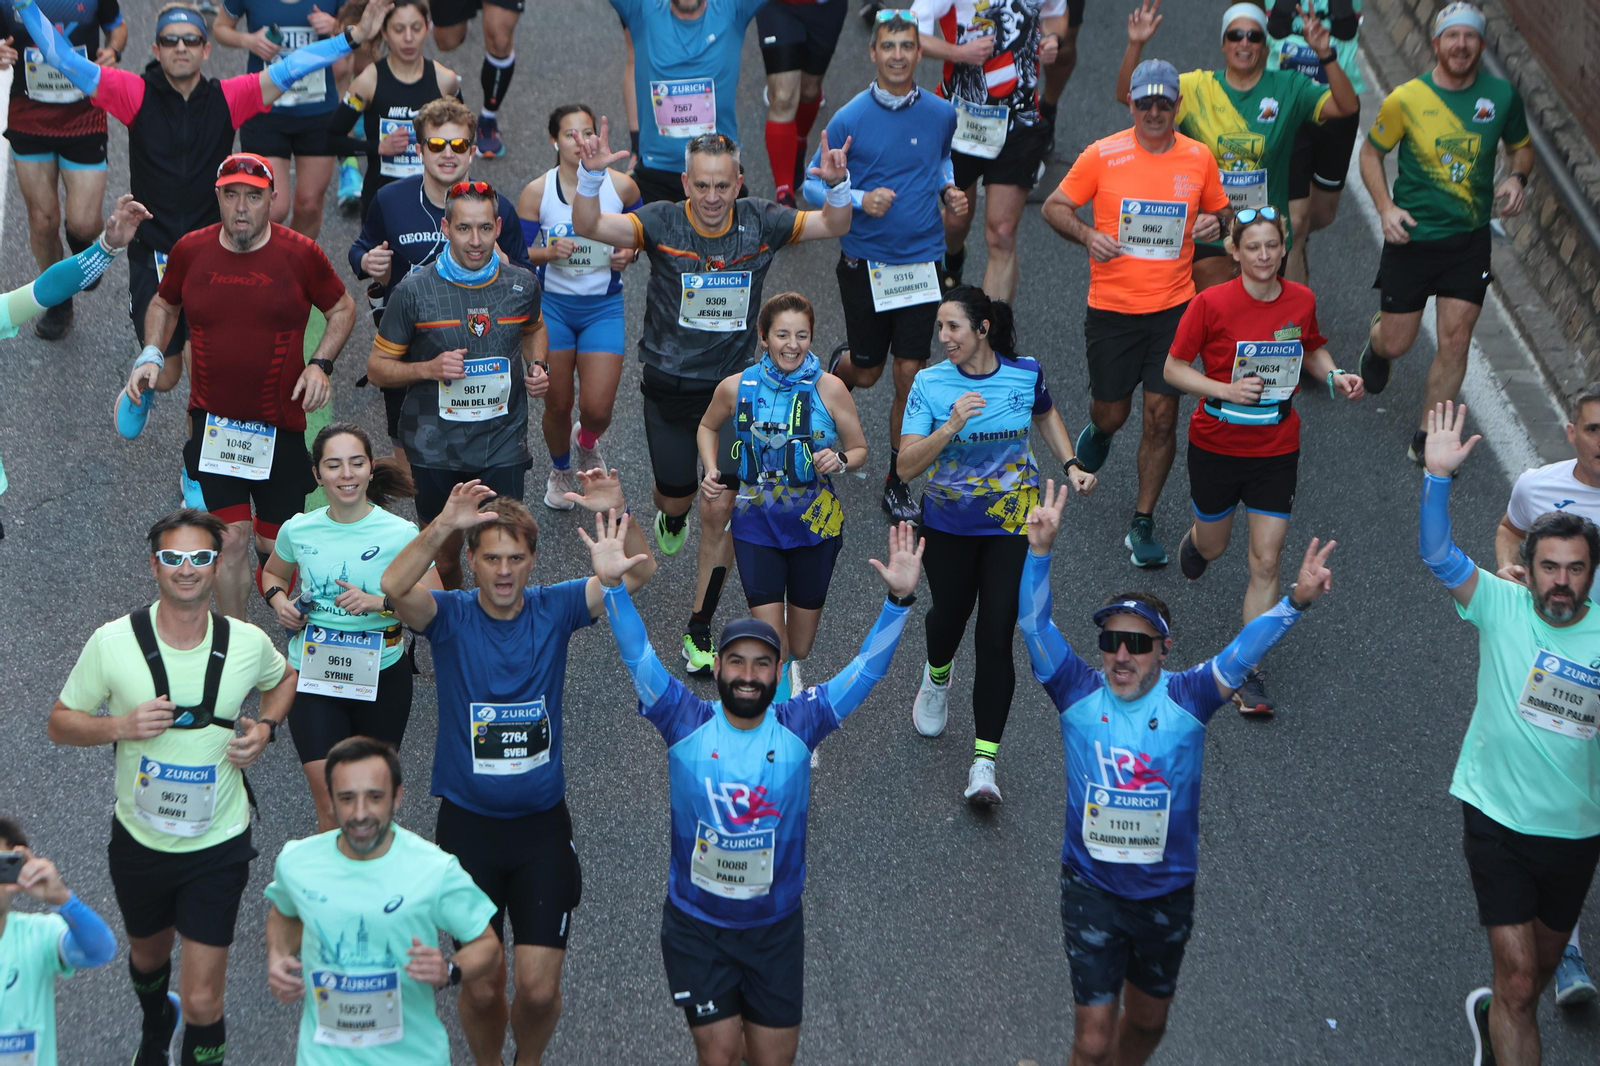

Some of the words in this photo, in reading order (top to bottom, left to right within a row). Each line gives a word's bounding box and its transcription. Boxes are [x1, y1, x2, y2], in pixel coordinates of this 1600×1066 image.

[671, 83, 705, 95] ZURICH
[387, 106, 408, 118] NIKE
[673, 104, 693, 113] 7567
[968, 107, 1000, 118] ZURICH
[671, 116, 698, 124] ROSSCO
[1226, 175, 1259, 184] ZURICH
[1144, 204, 1179, 215] ZURICH
[1142, 224, 1163, 234] 9962
[1127, 235, 1151, 244] PEDRO
[1152, 237, 1174, 245] LOPES
[573, 245, 592, 255] 0901
[568, 258, 591, 266] SALAS
[707, 276, 743, 286] ZURICH
[893, 272, 915, 283] 9316
[884, 281, 929, 296] NASCIMENTO
[705, 297, 727, 306] 9309
[697, 308, 721, 317] JESÚS
[722, 309, 733, 317] HB
[1260, 345, 1295, 355] ZURICH
[464, 363, 500, 373] ZURICH
[1254, 364, 1281, 374] 10634
[463, 385, 487, 395] 9817
[450, 398, 471, 407] DANI
[471, 397, 486, 406] DEL
[488, 397, 500, 406] RIO
[231, 419, 267, 433] ZURICH
[226, 438, 252, 451] 10462
[220, 451, 236, 461] DON
[237, 453, 254, 464] BENI
[330, 633, 373, 646] ZURICH
[328, 655, 352, 668] 9619
[324, 670, 355, 682] SYRINE
[1551, 687, 1585, 706] 11103
[500, 707, 543, 719] ZURICH
[1527, 695, 1565, 715] ROMERO
[1566, 707, 1596, 724] PALMA
[501, 731, 529, 744] 2764
[503, 747, 528, 758] SVEN
[164, 767, 209, 782] ZURICH
[161, 791, 188, 805] 9673
[1114, 795, 1159, 808] ZURICH
[1108, 819, 1141, 832] 11011
[721, 832, 765, 849] ZURICH
[1089, 831, 1127, 846] CLAUDIO
[1128, 832, 1161, 847] MUÑOZ
[715, 857, 748, 872] 10088
[715, 872, 745, 884] PABLO
[339, 975, 388, 991] ZURICH
[338, 1002, 372, 1016] 10572
